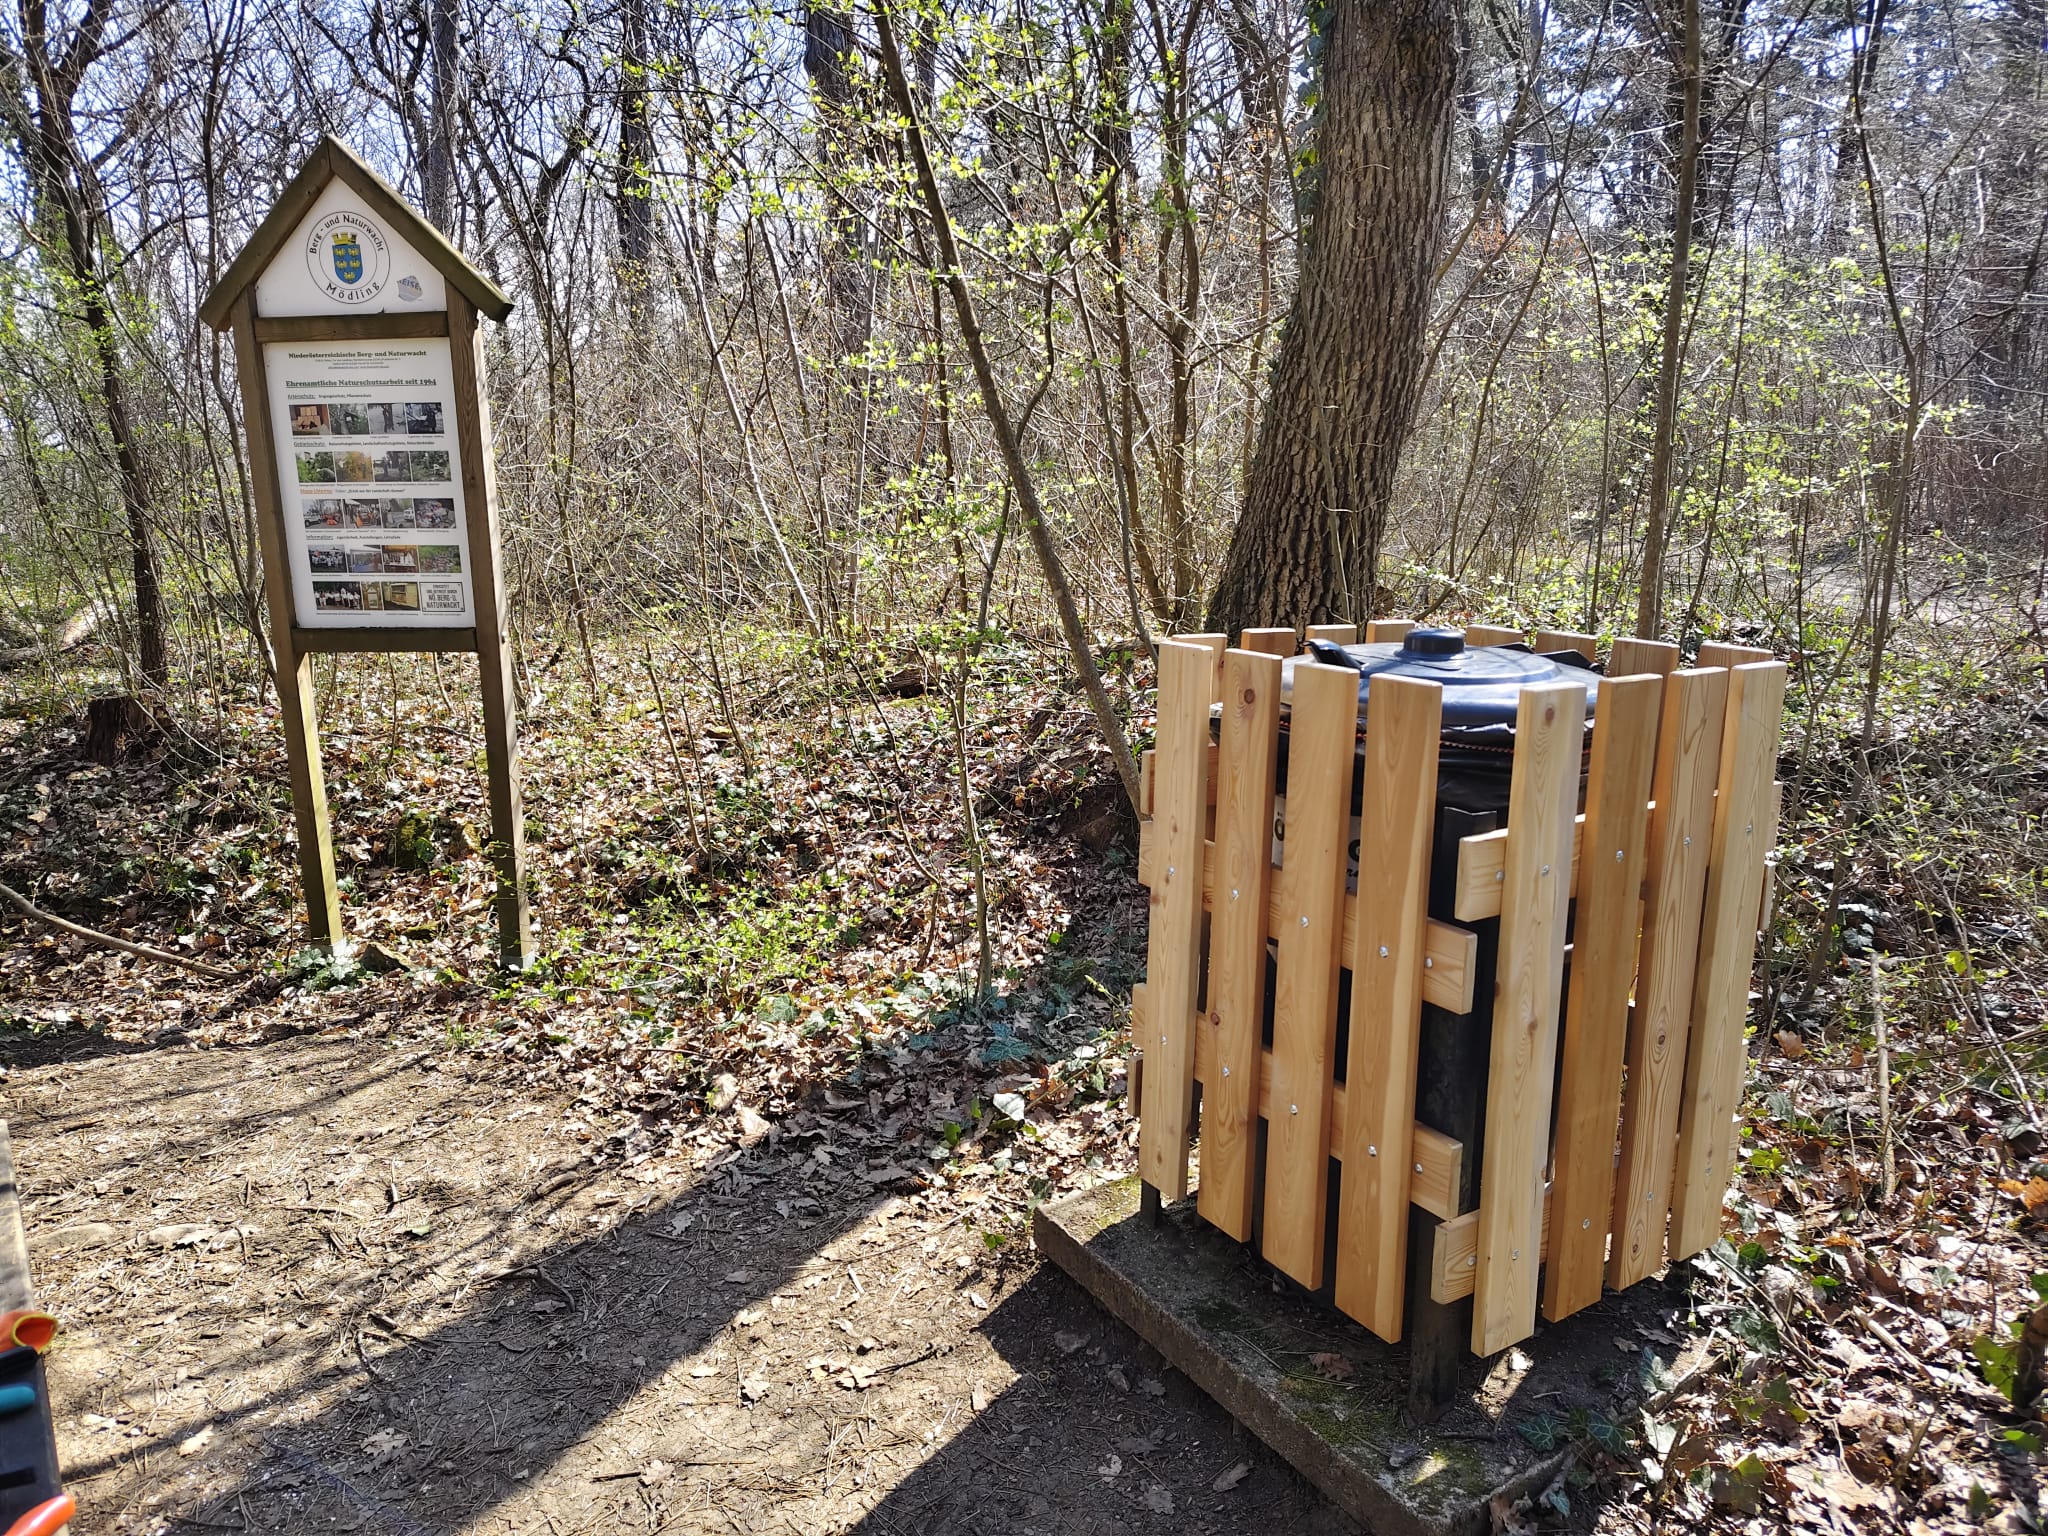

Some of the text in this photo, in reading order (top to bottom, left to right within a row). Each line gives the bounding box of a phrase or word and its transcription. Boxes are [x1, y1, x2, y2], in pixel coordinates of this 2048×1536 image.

[325, 215, 340, 229] und
[342, 214, 384, 252] Naturwacht
[325, 282, 380, 301] Mödling
[285, 380, 337, 388] Ehrenamtliche
[338, 379, 403, 387] Naturschutzarbeit
